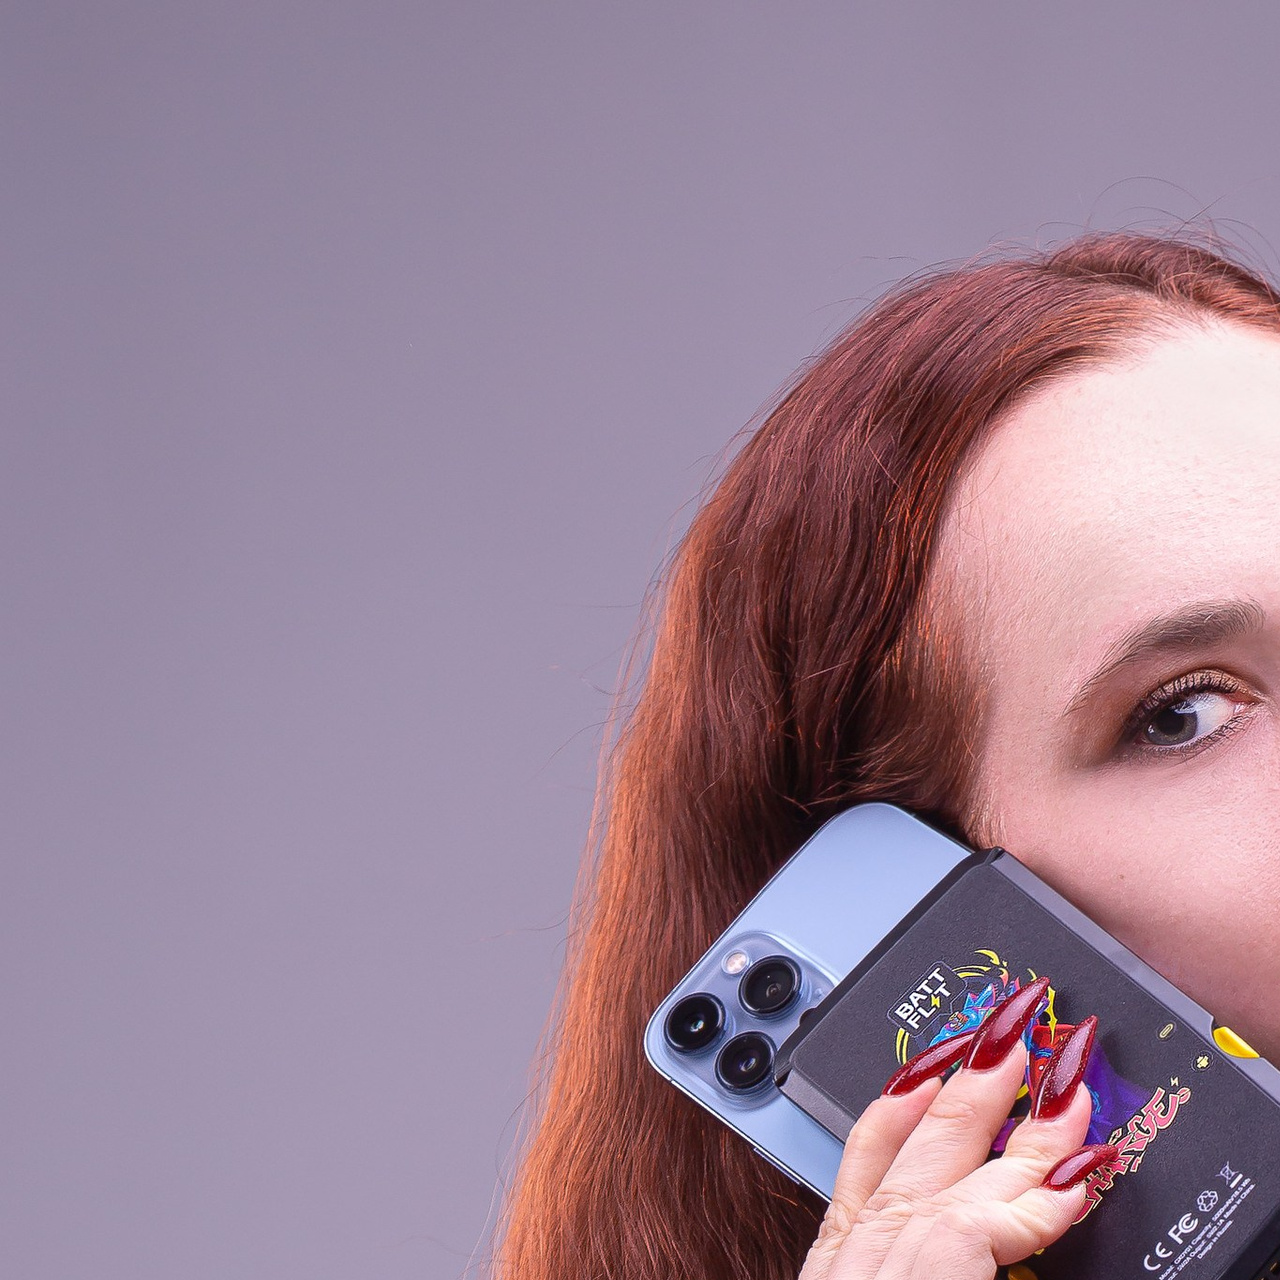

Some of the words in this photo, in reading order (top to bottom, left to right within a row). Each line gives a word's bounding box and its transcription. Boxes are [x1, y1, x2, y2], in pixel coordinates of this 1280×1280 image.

[894, 967, 945, 1020] BATT
[1071, 1086, 1180, 1225] HARGE
[1143, 1241, 1173, 1271] CE
